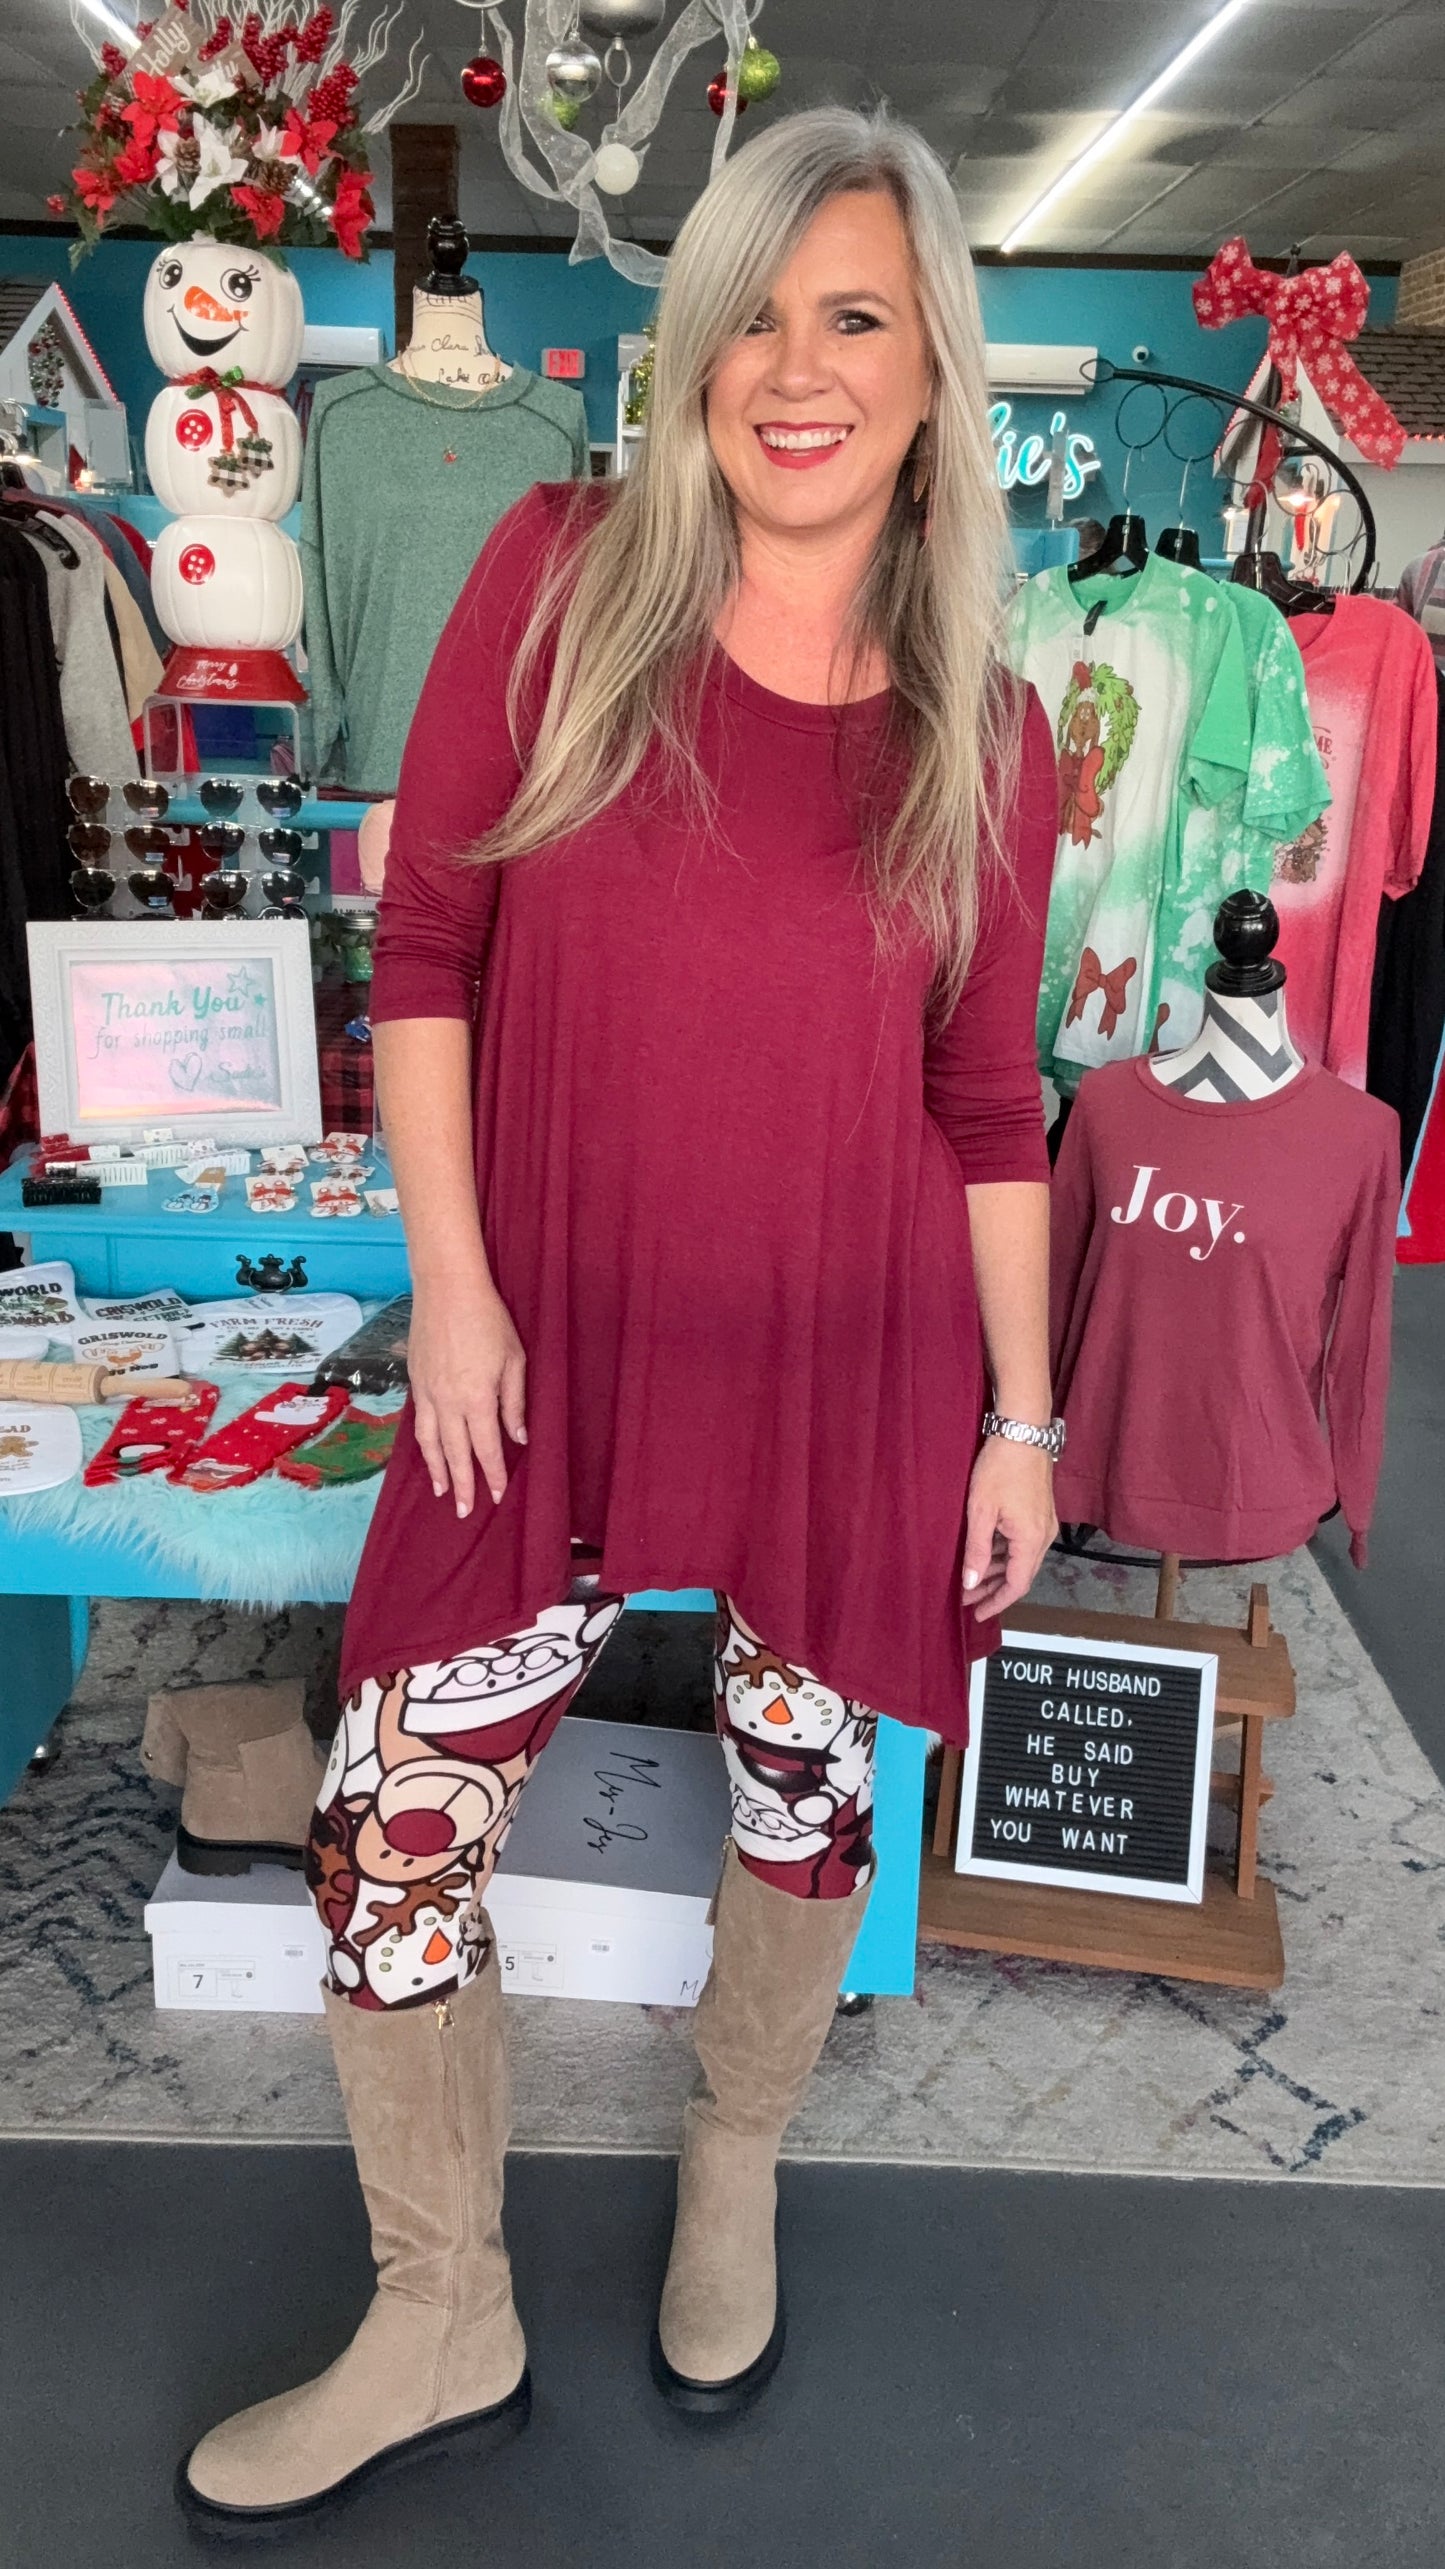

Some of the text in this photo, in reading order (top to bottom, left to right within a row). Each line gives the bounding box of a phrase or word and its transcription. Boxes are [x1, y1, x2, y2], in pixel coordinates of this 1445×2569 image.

[101, 986, 242, 1025] Thank You
[87, 1013, 266, 1060] for shopping small
[1110, 1164, 1246, 1261] Joy.
[77, 1331, 168, 1345] GRISWOLD
[264, 1317, 324, 1328] FRESH
[1001, 1659, 1162, 1697] YOUR HUSBAND
[1026, 1733, 1134, 1765] HE SAID
[1051, 1763, 1100, 1788] BUY
[1005, 1785, 1134, 1821] WHATEVER
[990, 1818, 1128, 1855] YOU WANT
[192, 1974, 204, 1989] 7
